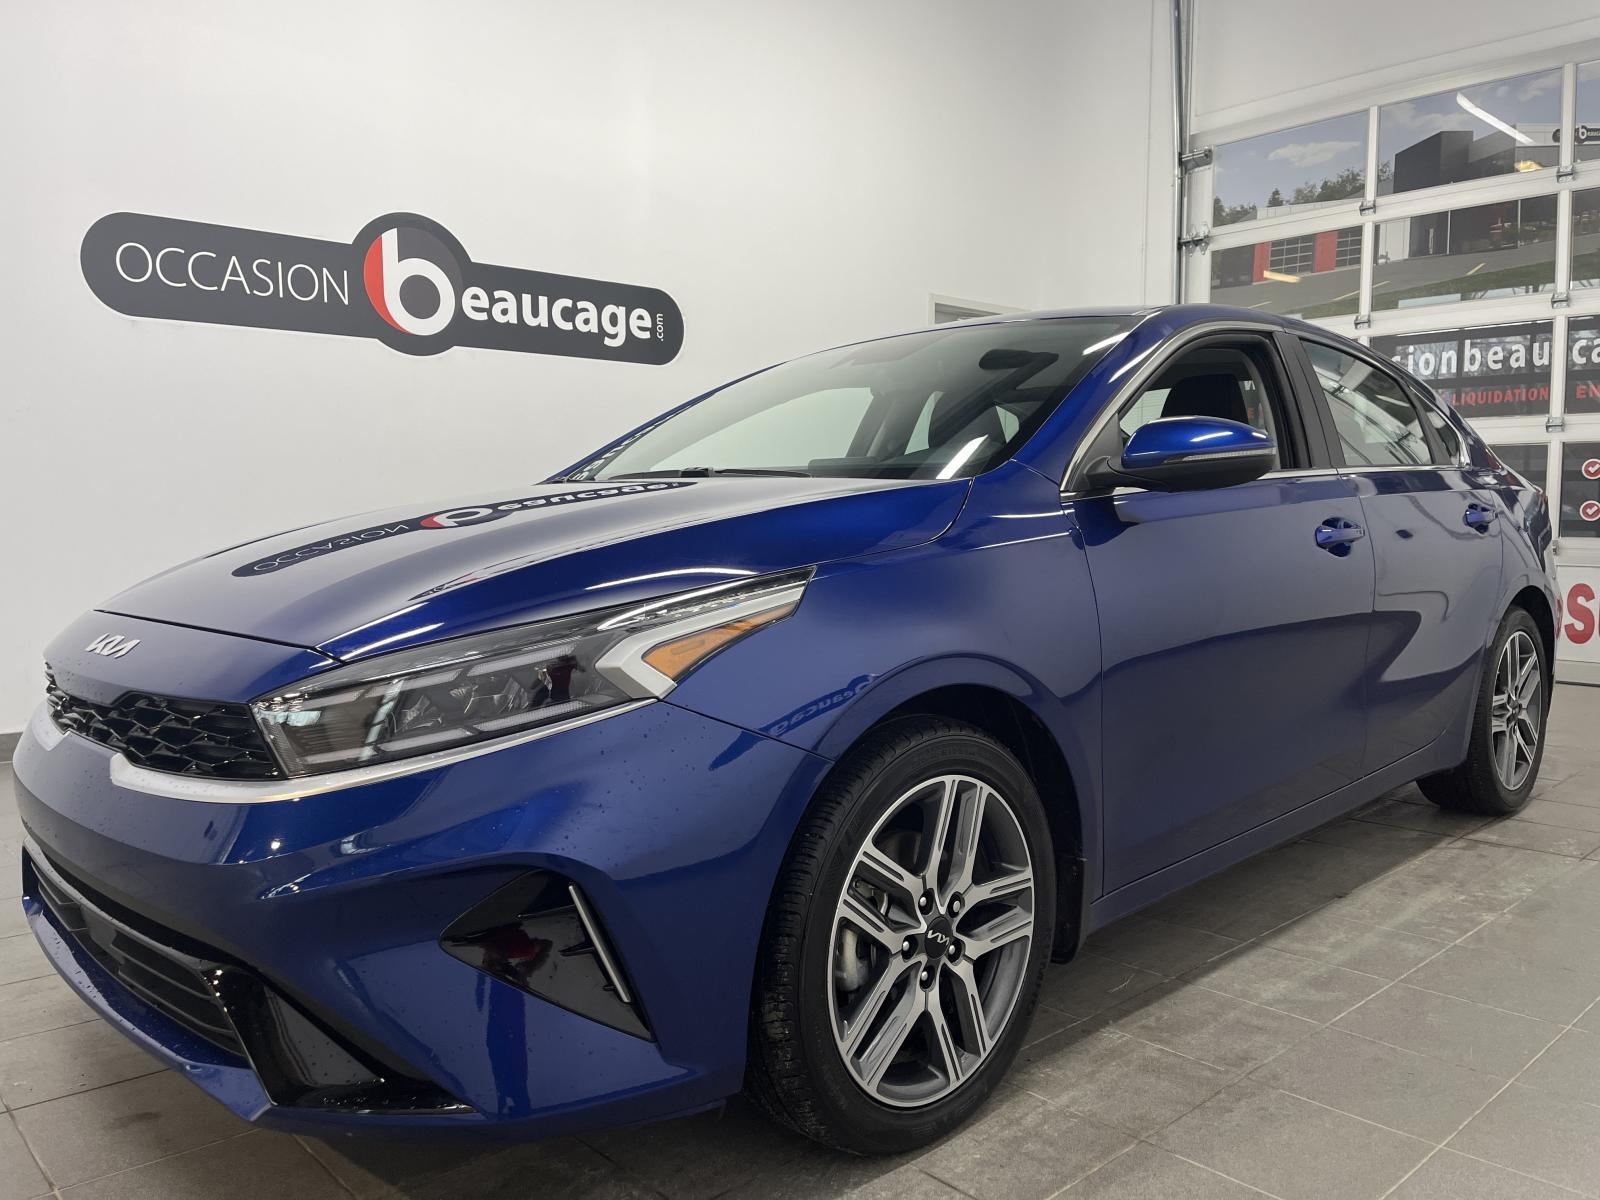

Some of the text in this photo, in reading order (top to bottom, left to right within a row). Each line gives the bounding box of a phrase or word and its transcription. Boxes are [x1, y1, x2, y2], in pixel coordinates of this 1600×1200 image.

[115, 227, 664, 347] OCCASION beaucage .com
[1452, 386, 1550, 407] LIQUIDATION
[1564, 582, 1600, 645] S
